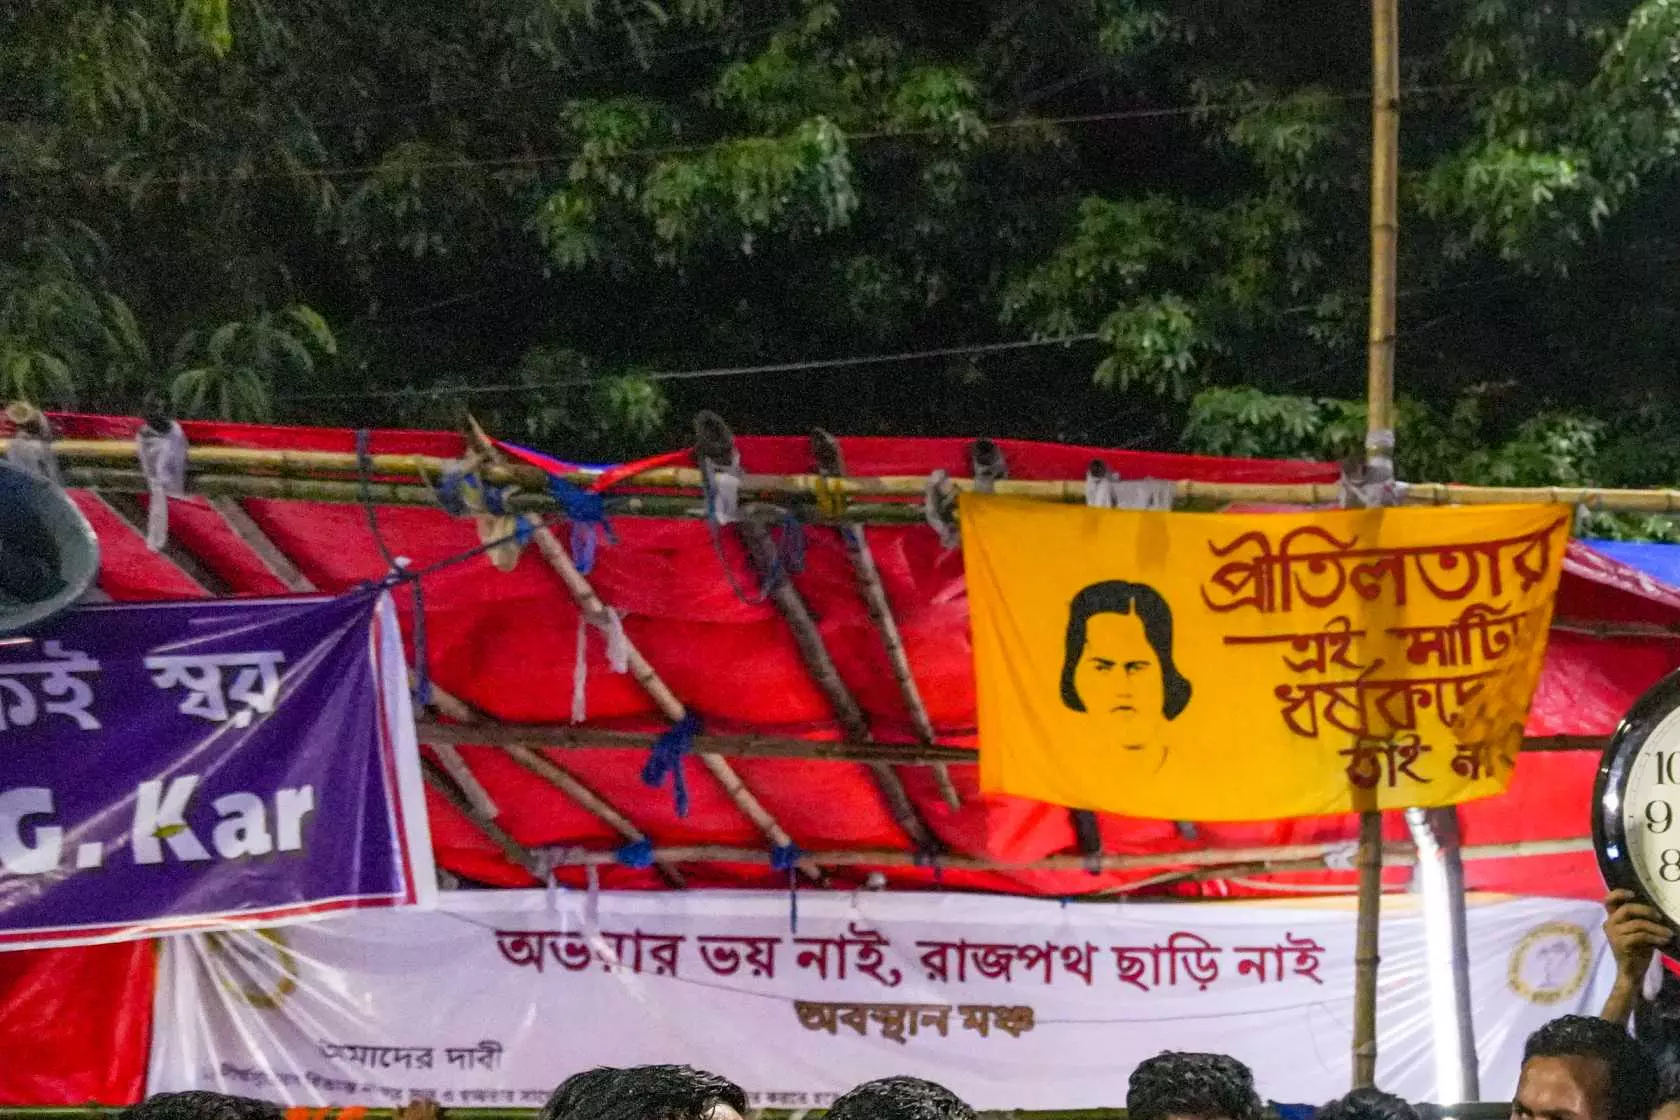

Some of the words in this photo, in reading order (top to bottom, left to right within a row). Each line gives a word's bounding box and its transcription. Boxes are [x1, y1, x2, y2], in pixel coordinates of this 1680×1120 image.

[1200, 515, 1568, 614] প্রীতিলতার
[1385, 603, 1532, 668] মাটি
[133, 774, 315, 866] Kar
[1645, 800, 1673, 833] 9
[495, 929, 686, 978] অভয়ার
[697, 935, 783, 979] ভয়
[793, 922, 902, 987] নাই,
[916, 937, 1099, 986] রাজপথ
[1111, 931, 1223, 992] ছাড়ি
[1234, 932, 1326, 985] নাই
[792, 1000, 952, 1044] অবস্থান
[957, 1005, 1036, 1039] মঞ্চ
[445, 1039, 503, 1072] দাবী
